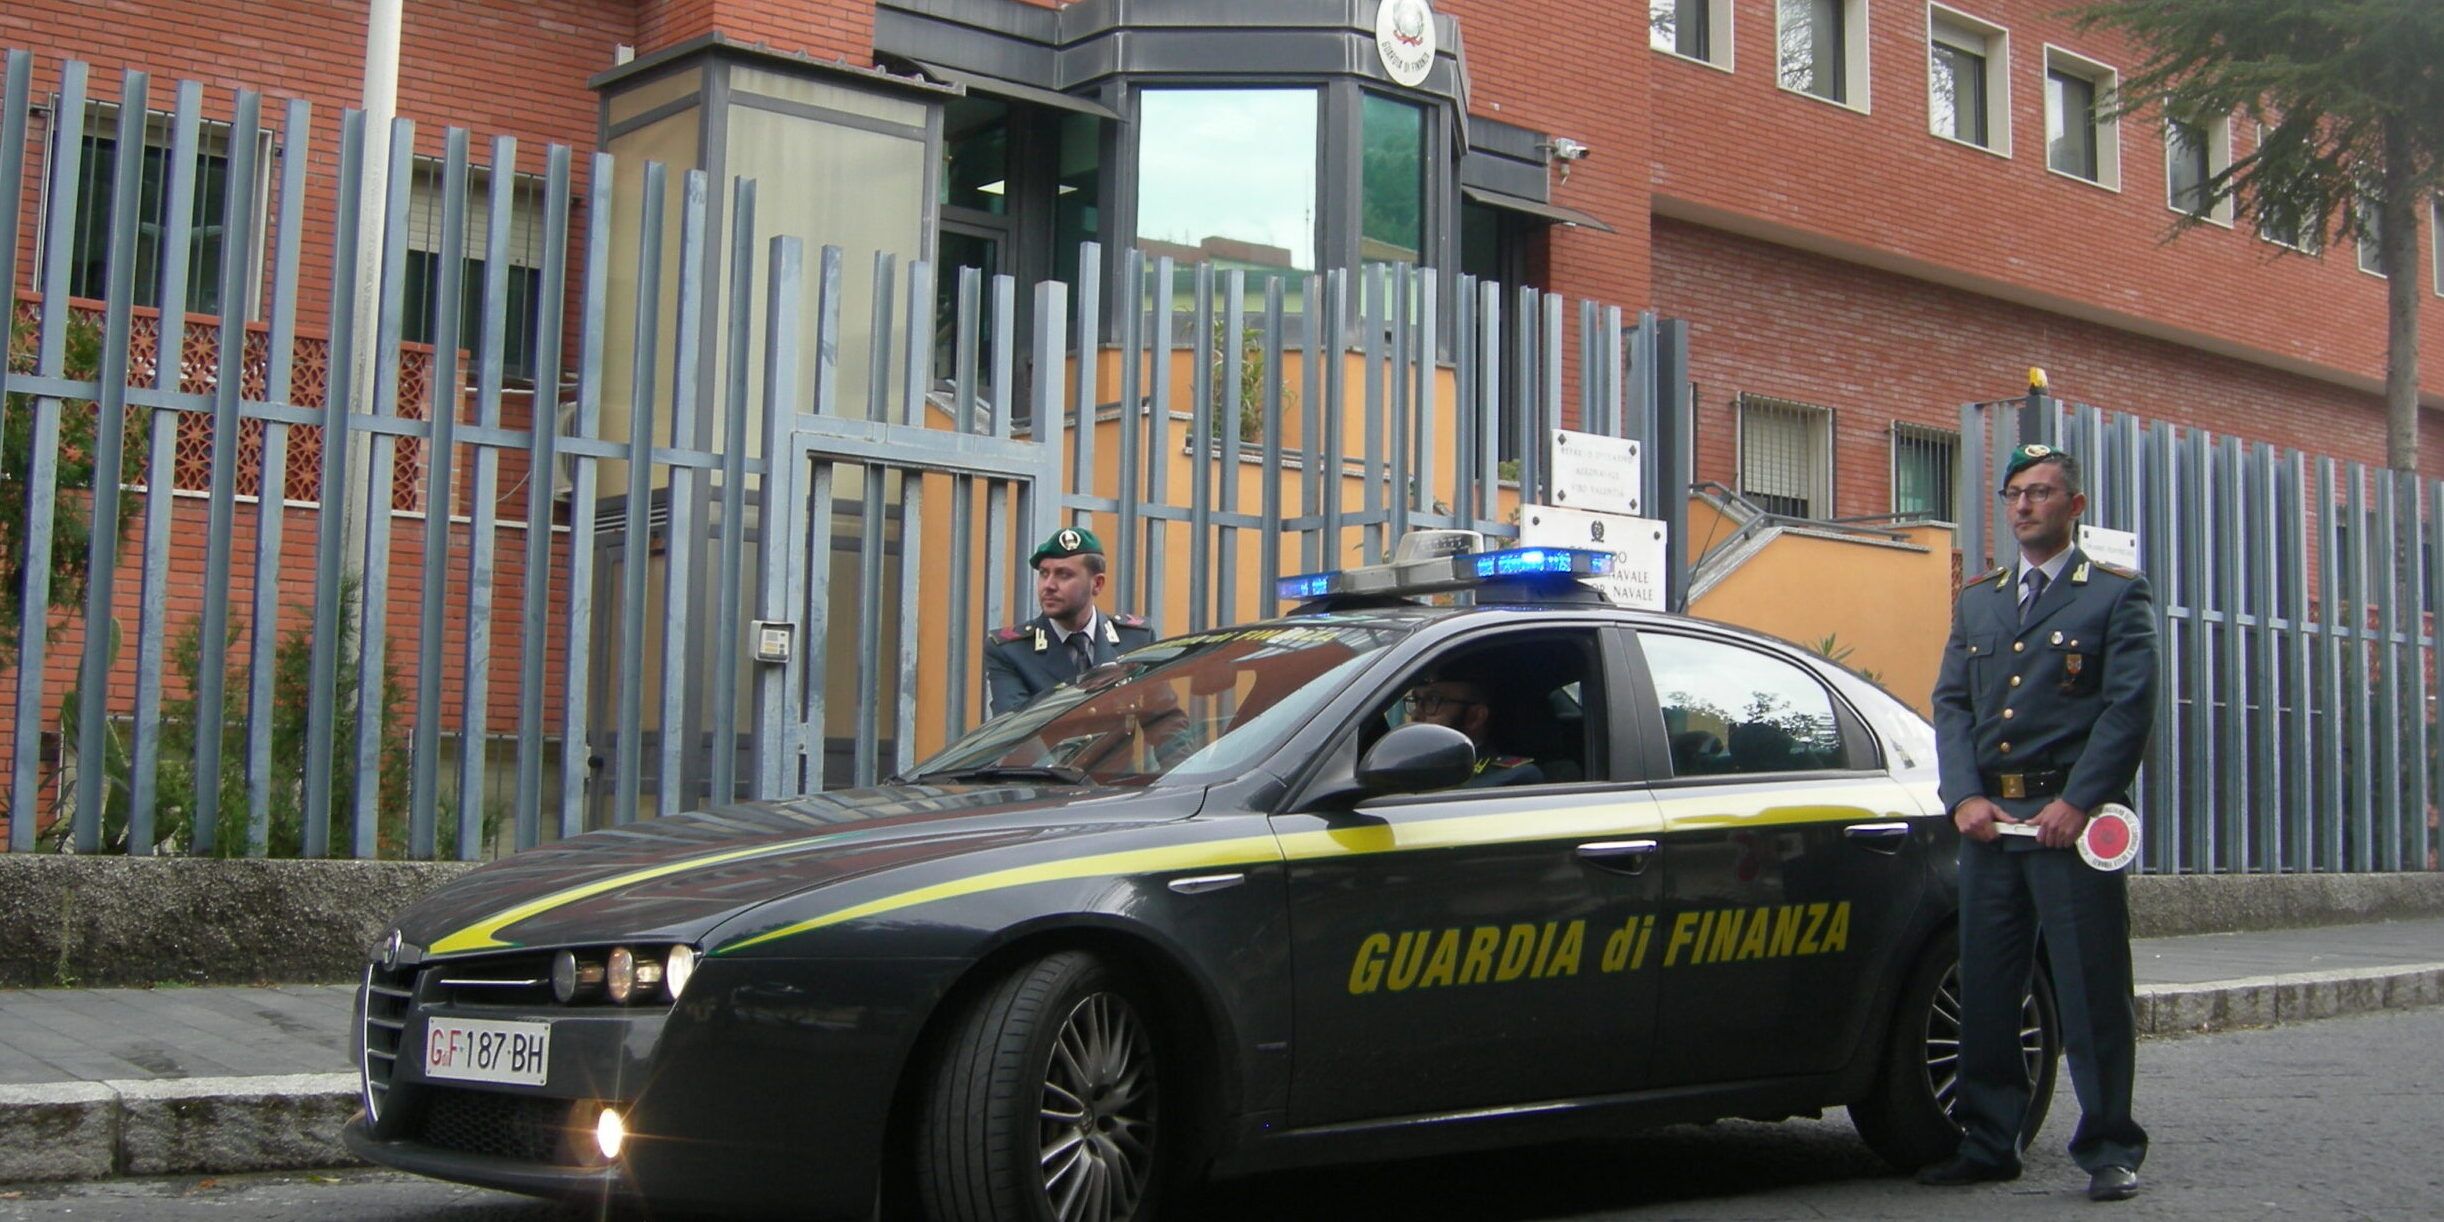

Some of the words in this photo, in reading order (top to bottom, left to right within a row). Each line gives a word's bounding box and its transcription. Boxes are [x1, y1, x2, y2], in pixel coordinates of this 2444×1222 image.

[1613, 585, 1653, 601] NAVALE
[1348, 919, 1586, 995] GUARDIA
[1601, 915, 1655, 973] di
[1663, 902, 1851, 967] FINANZA
